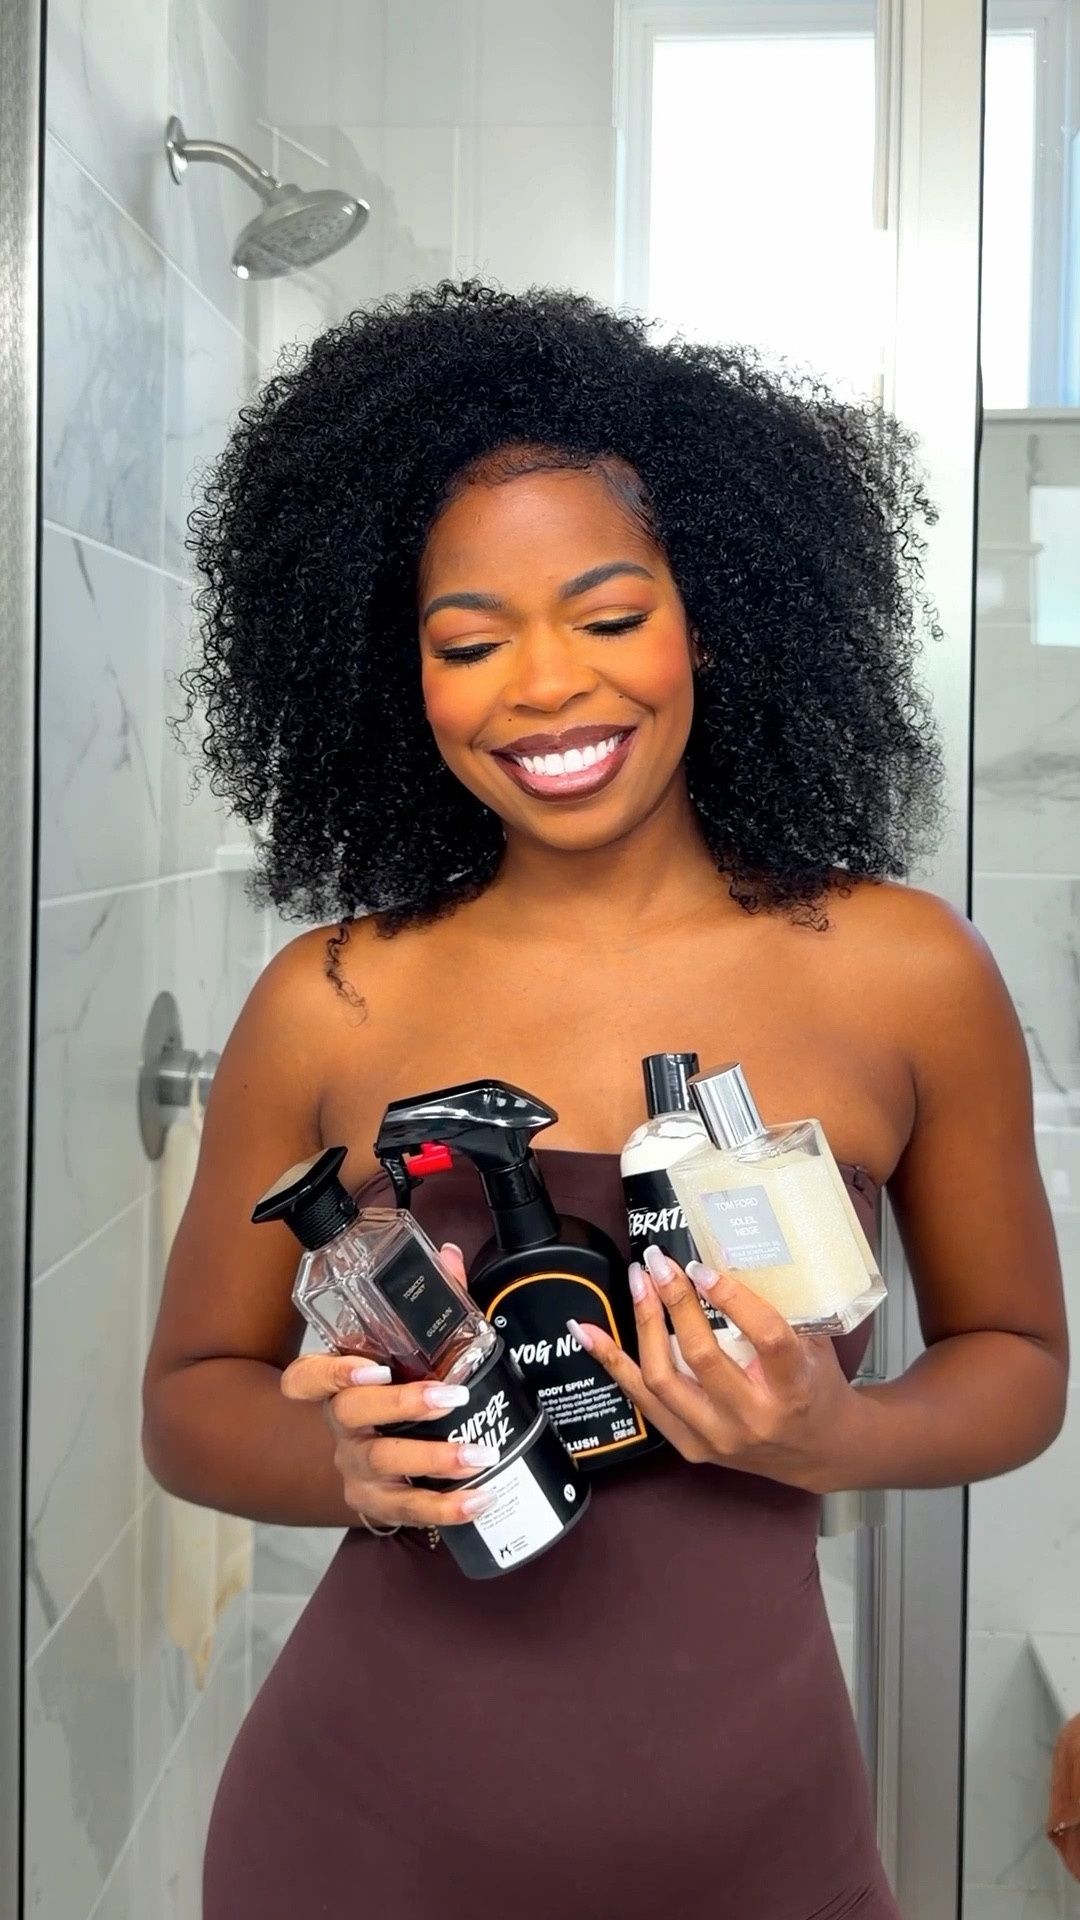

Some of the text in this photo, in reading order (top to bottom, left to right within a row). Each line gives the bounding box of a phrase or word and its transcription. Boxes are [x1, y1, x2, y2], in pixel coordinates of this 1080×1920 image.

[715, 1197, 759, 1211] TOM FORD
[427, 1307, 453, 1337] GUERLAIN
[510, 1340, 553, 1366] YOG
[538, 1377, 595, 1398] BODY SPRAY
[448, 1391, 510, 1443] SUPER
[567, 1436, 600, 1451] LUSH
